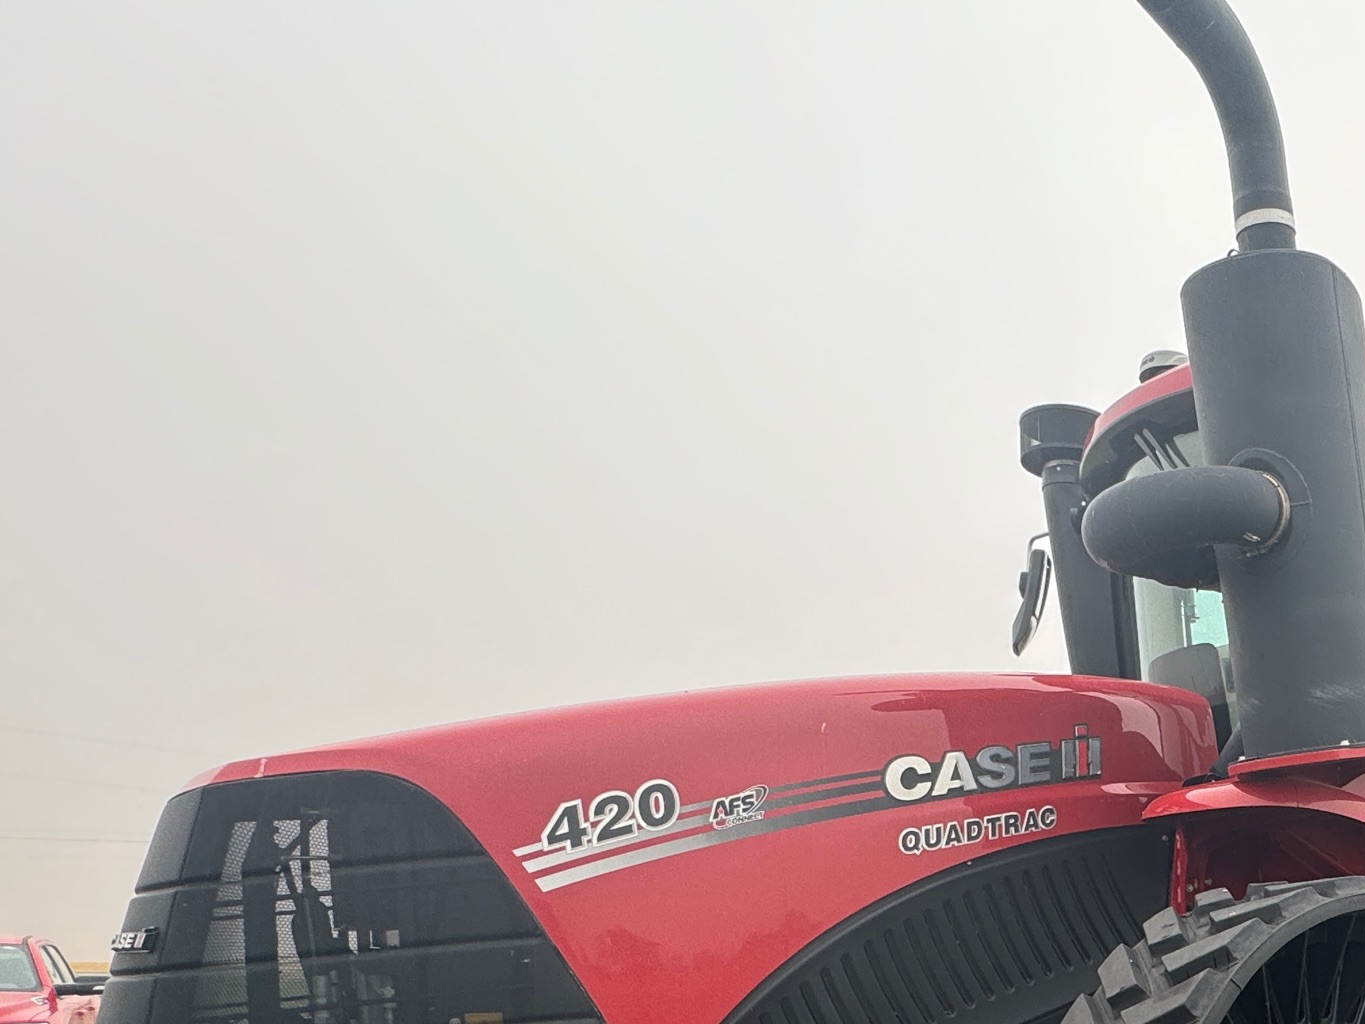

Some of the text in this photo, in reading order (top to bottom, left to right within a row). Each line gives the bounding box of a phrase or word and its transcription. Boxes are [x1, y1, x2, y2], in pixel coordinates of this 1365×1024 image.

[885, 742, 1052, 801] CASE
[541, 779, 681, 854] 420
[710, 791, 756, 821] AFS
[726, 811, 765, 826] CONNECT
[898, 805, 1058, 855] QUADTRAC
